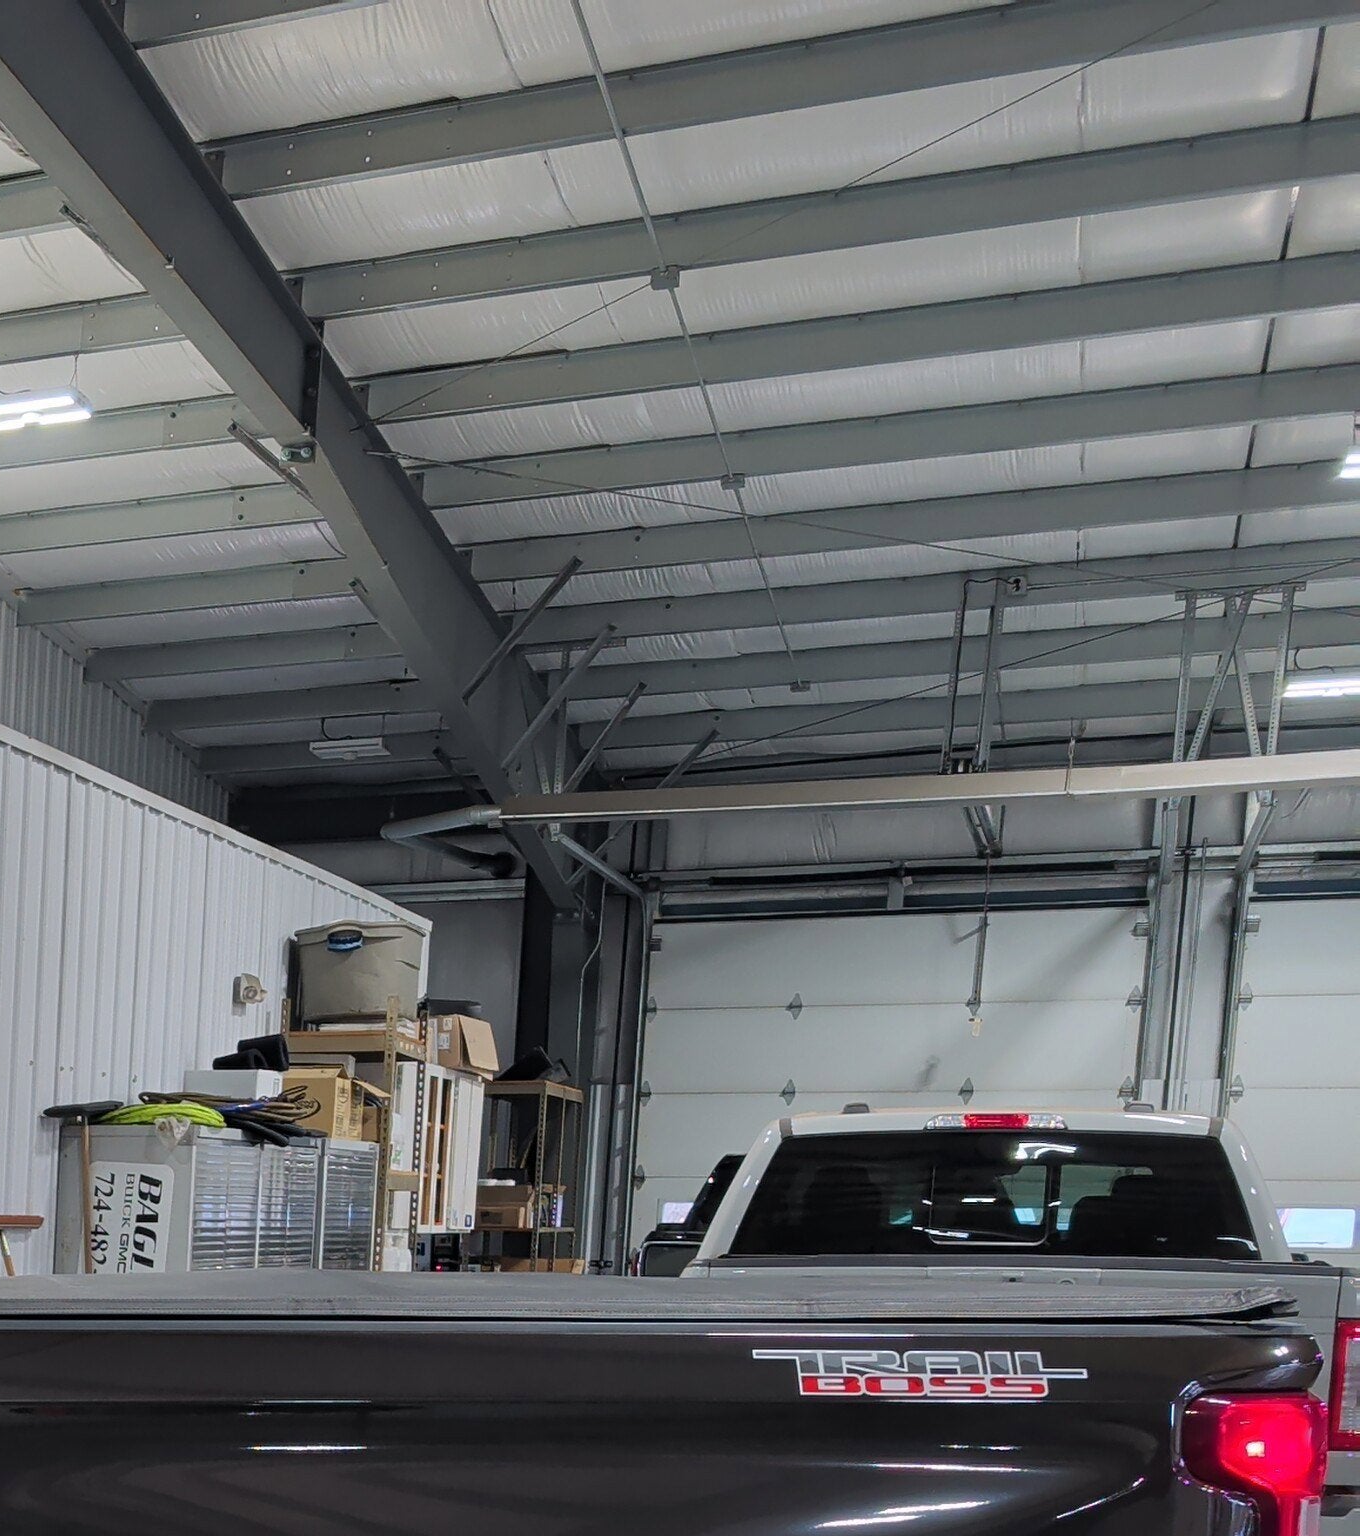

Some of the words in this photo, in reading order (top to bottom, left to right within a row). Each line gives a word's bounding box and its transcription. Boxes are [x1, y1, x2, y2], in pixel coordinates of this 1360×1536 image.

[121, 1173, 135, 1228] BUICK
[130, 1173, 163, 1270] BAGL
[116, 1233, 130, 1274] GMC
[752, 1349, 1088, 1379] TRAIL
[799, 1373, 1049, 1398] BOSS
